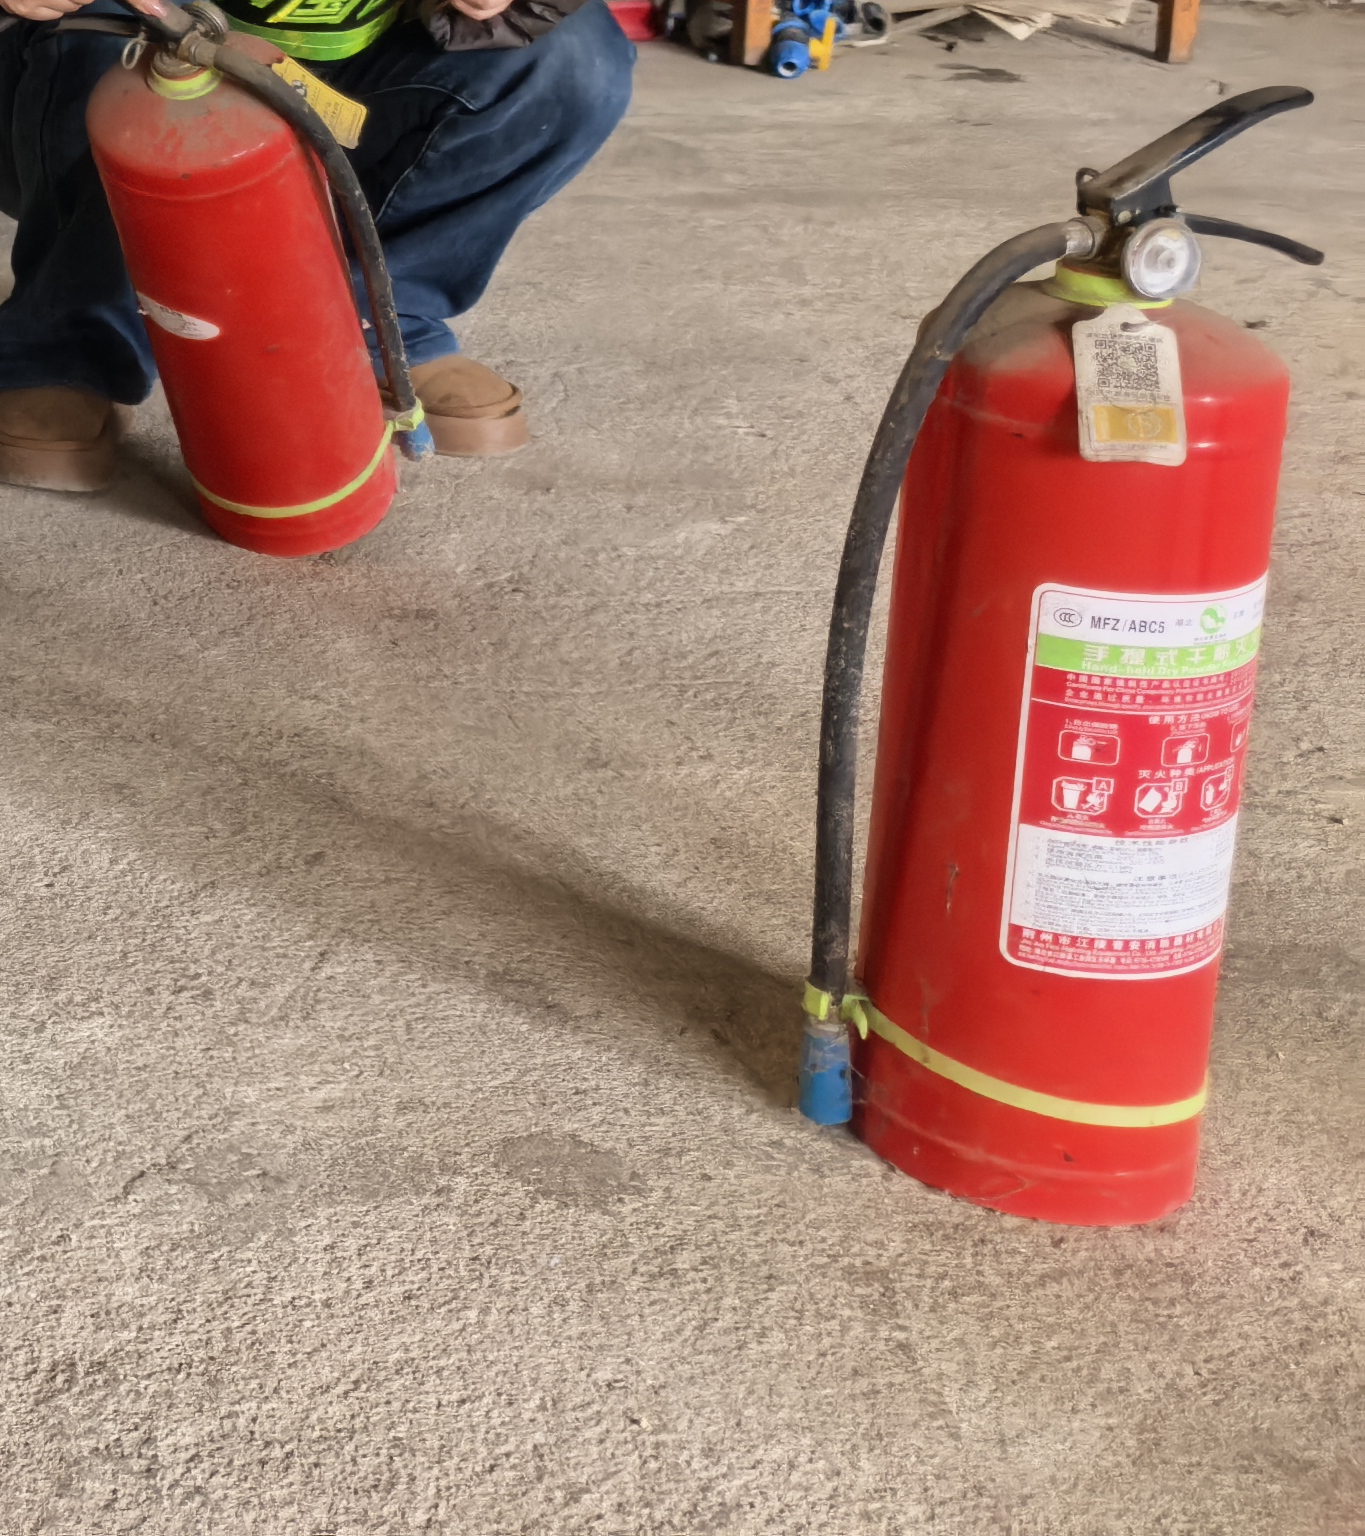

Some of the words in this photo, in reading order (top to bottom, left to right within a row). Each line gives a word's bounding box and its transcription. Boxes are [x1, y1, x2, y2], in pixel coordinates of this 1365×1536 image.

[1090, 615, 1166, 634] MFZ/ABC5
[1098, 780, 1109, 791] A
[1173, 781, 1182, 792] B
